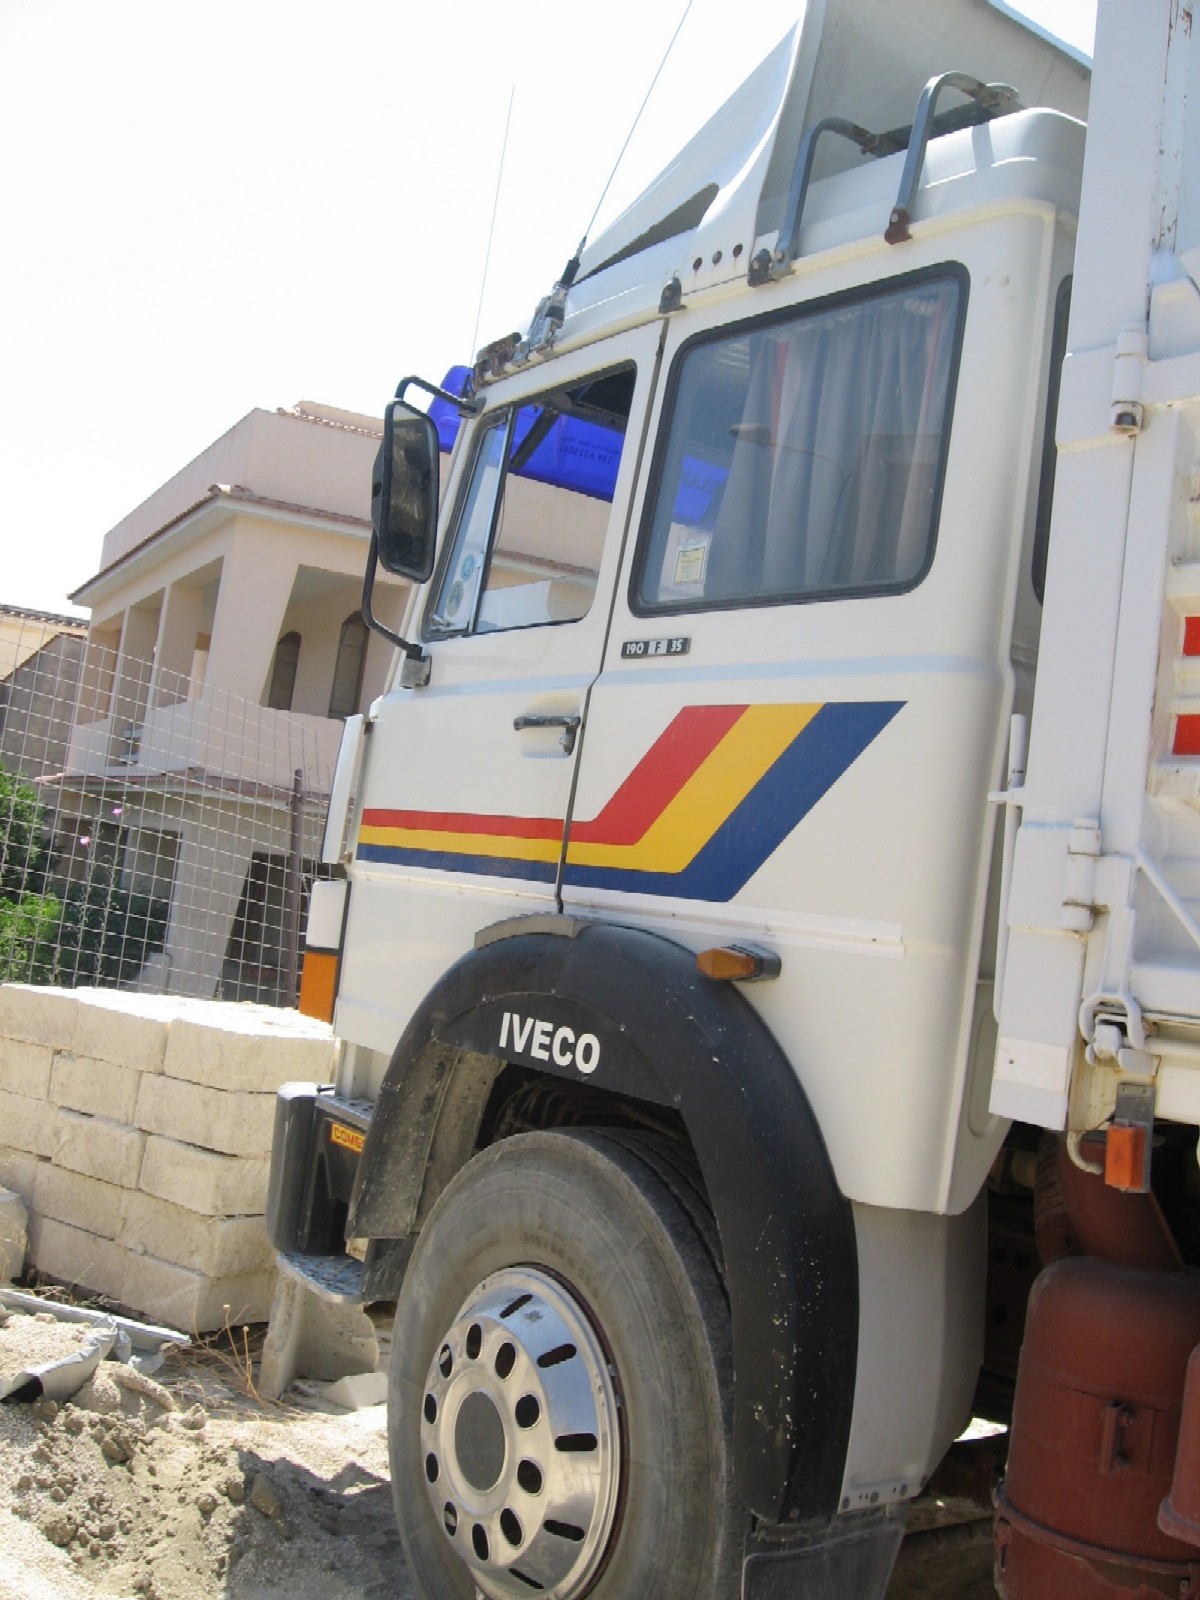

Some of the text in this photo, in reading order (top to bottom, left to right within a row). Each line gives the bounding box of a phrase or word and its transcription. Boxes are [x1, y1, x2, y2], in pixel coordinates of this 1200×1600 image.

[626, 639, 684, 655] 190 F 35
[499, 1012, 600, 1074] IVECO
[334, 1126, 365, 1149] COME
